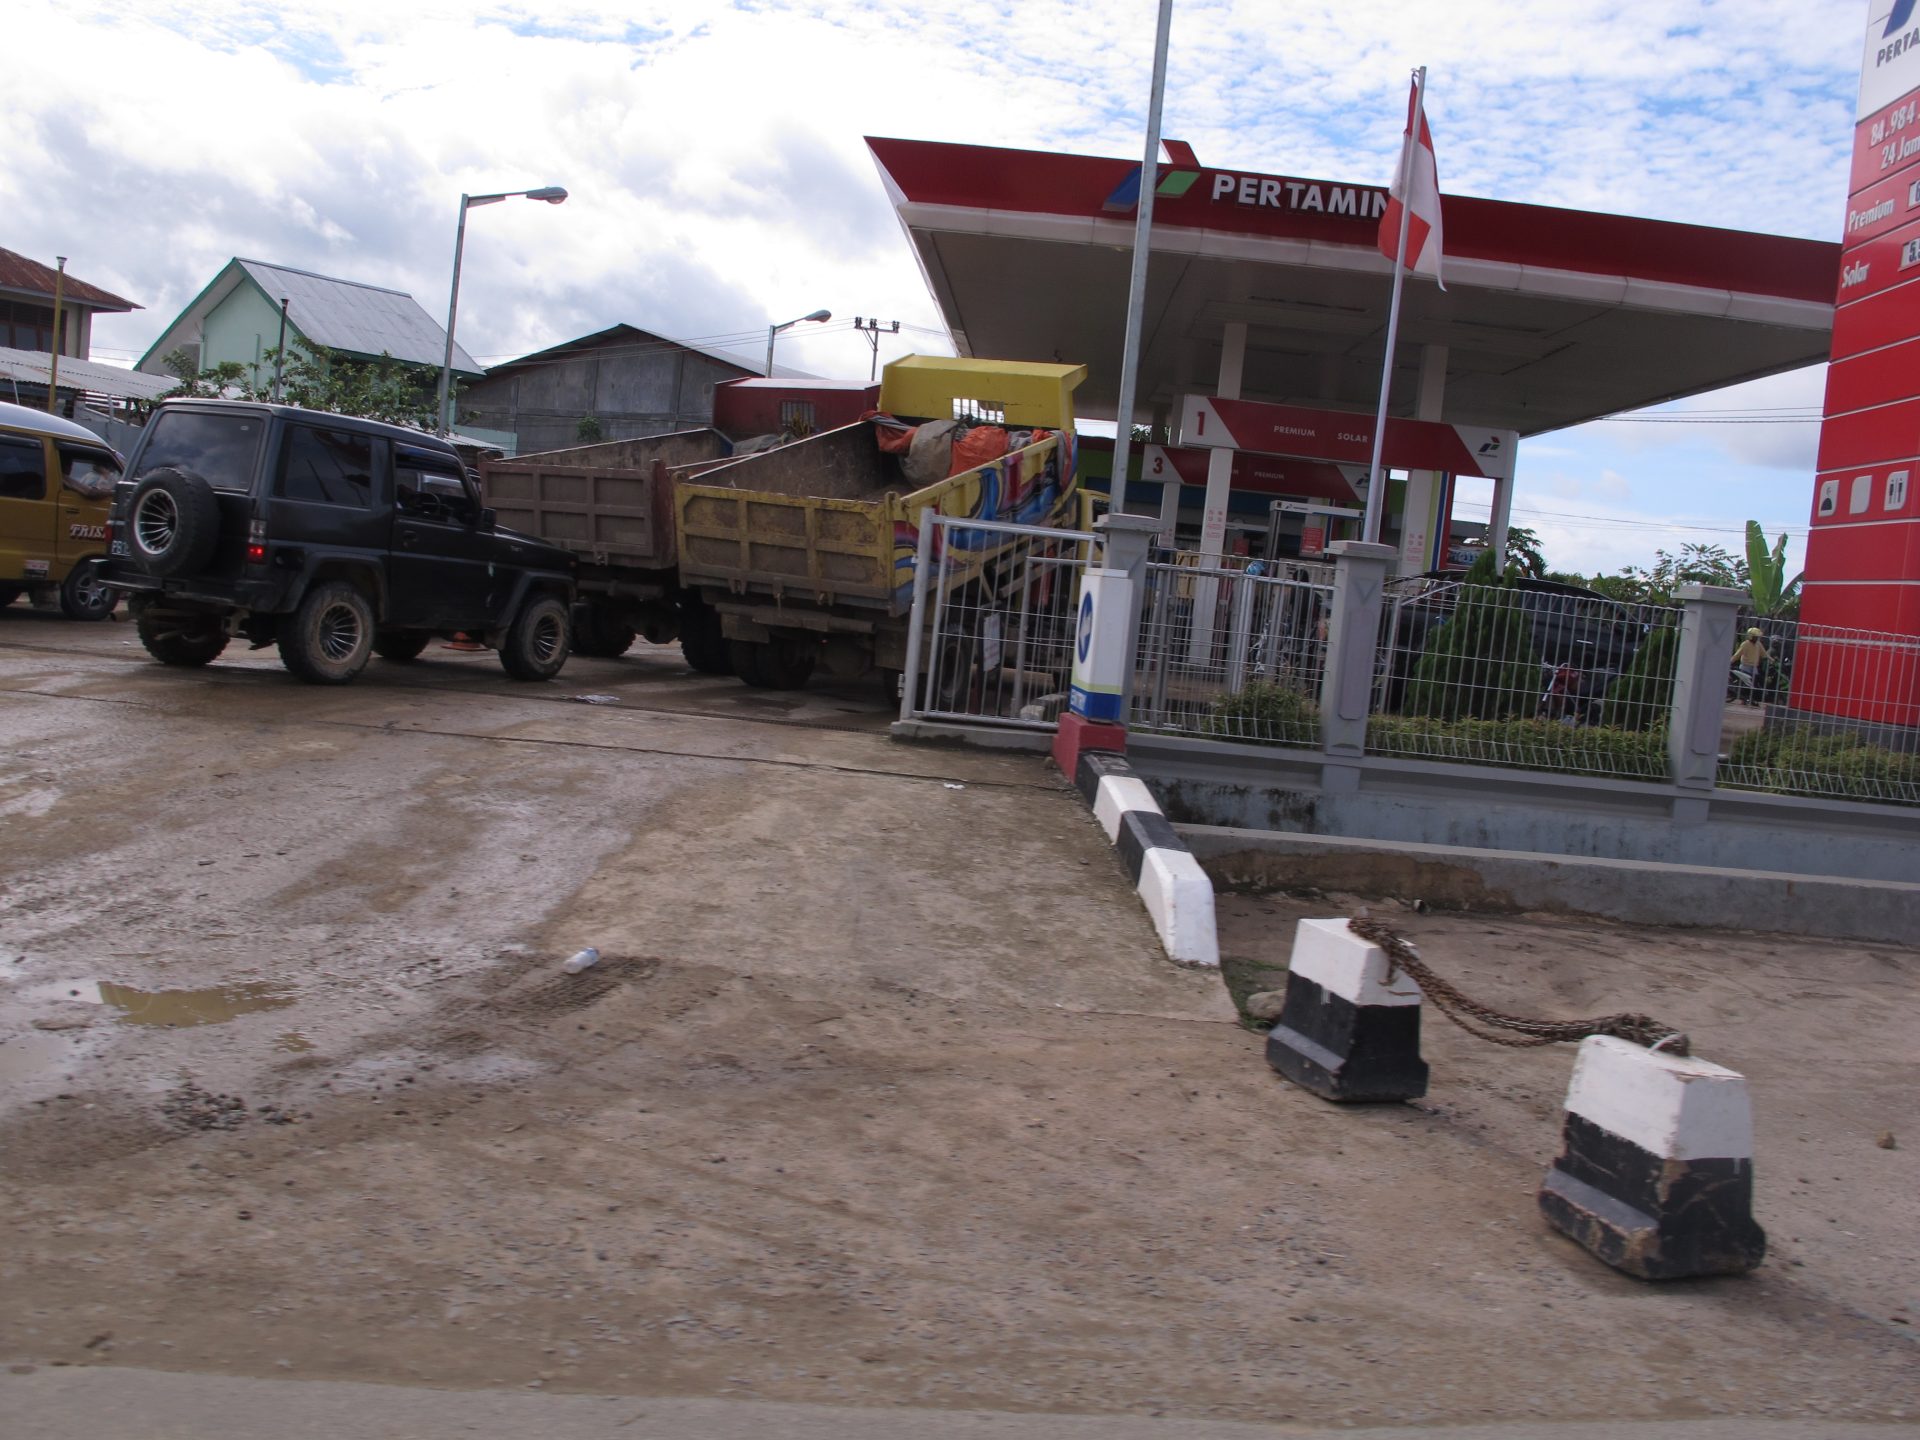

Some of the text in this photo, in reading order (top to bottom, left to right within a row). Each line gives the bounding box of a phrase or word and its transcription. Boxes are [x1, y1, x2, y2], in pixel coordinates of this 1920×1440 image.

[1876, 27, 1920, 68] PERTA
[1880, 142, 1896, 170] 24
[1211, 173, 1390, 219] PERTAMIN
[1848, 198, 1895, 234] Premium
[1841, 260, 1870, 289] Solar
[1197, 411, 1206, 436] 1
[1273, 425, 1369, 443] PREMIUM SOLAR
[1152, 456, 1164, 474] 3
[1254, 470, 1285, 481] PREMIUM
[69, 523, 107, 540] TRIS
